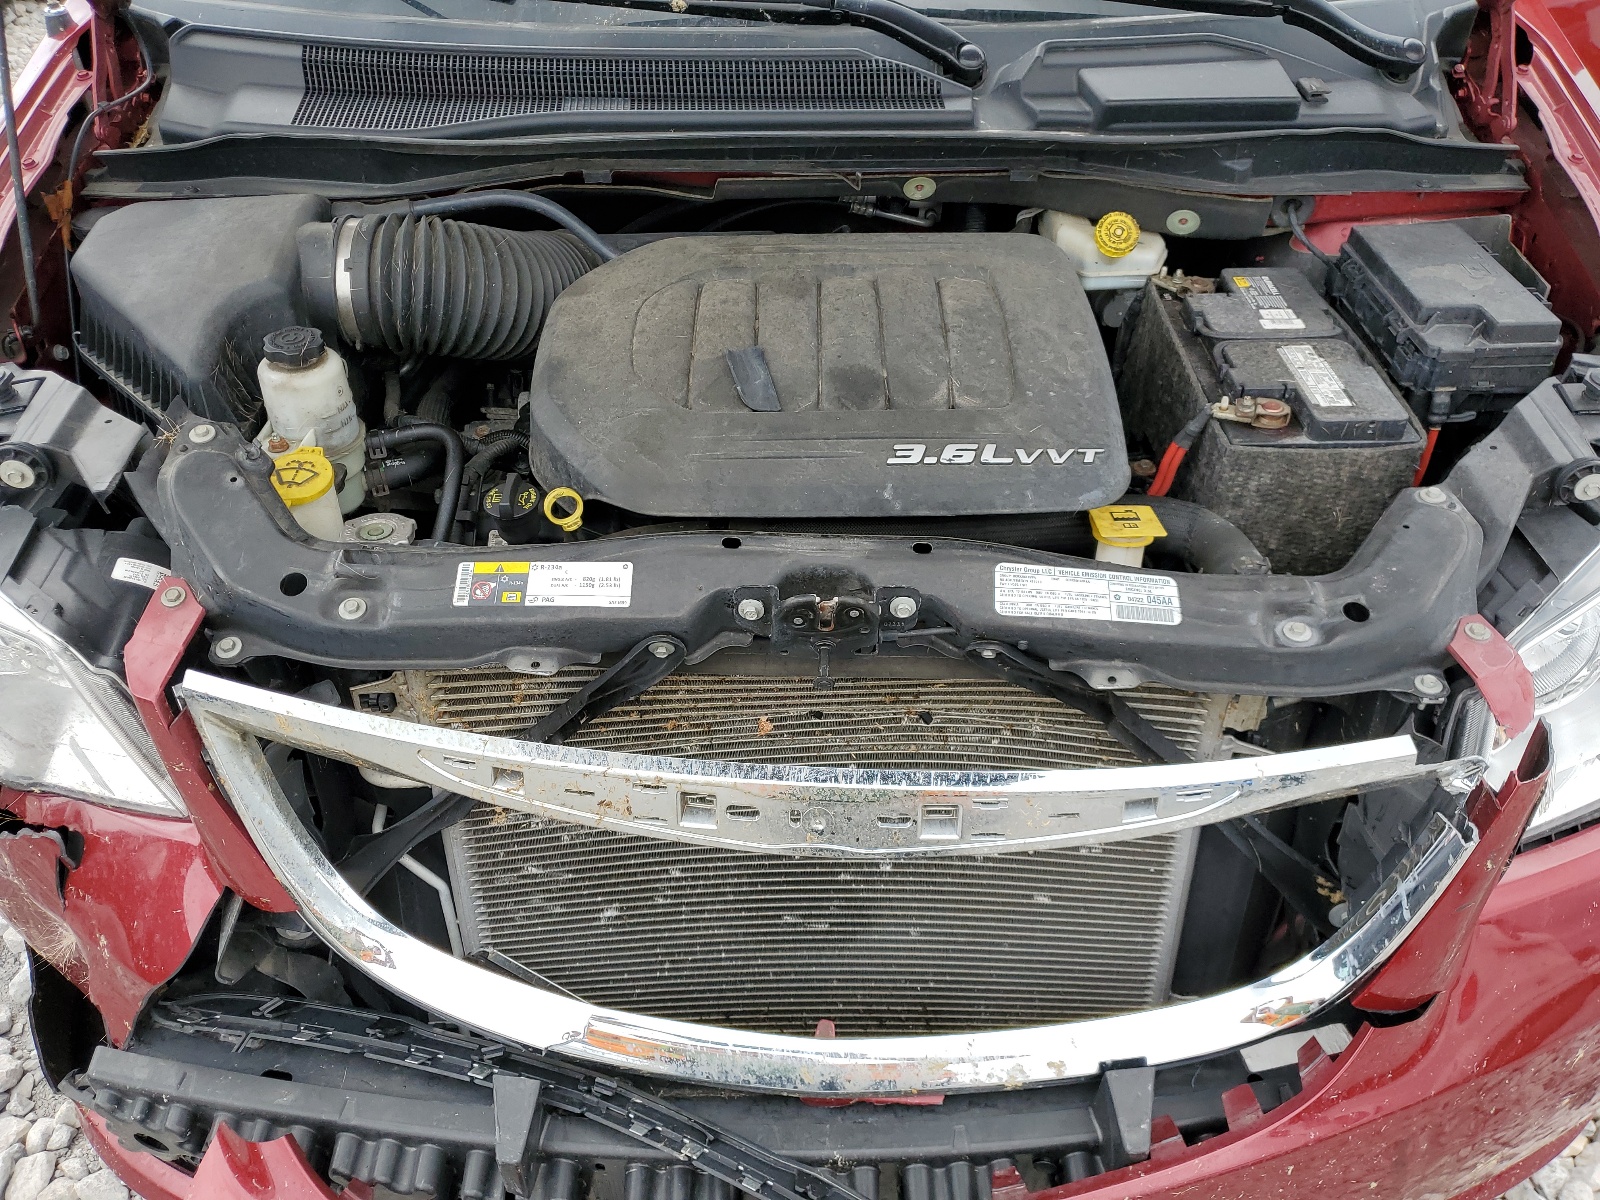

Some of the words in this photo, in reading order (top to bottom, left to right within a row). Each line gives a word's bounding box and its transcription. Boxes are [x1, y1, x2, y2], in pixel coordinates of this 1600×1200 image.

[999, 564, 1023, 573] Chrysler
[1023, 566, 1041, 575] Group
[1057, 569, 1081, 577] VEHICLE
[1081, 571, 1107, 580] EMISSION
[1108, 573, 1134, 582] CONTROL
[1134, 575, 1171, 585] INFORMATION
[541, 596, 556, 604] PAG
[1146, 595, 1173, 605] 045AA
